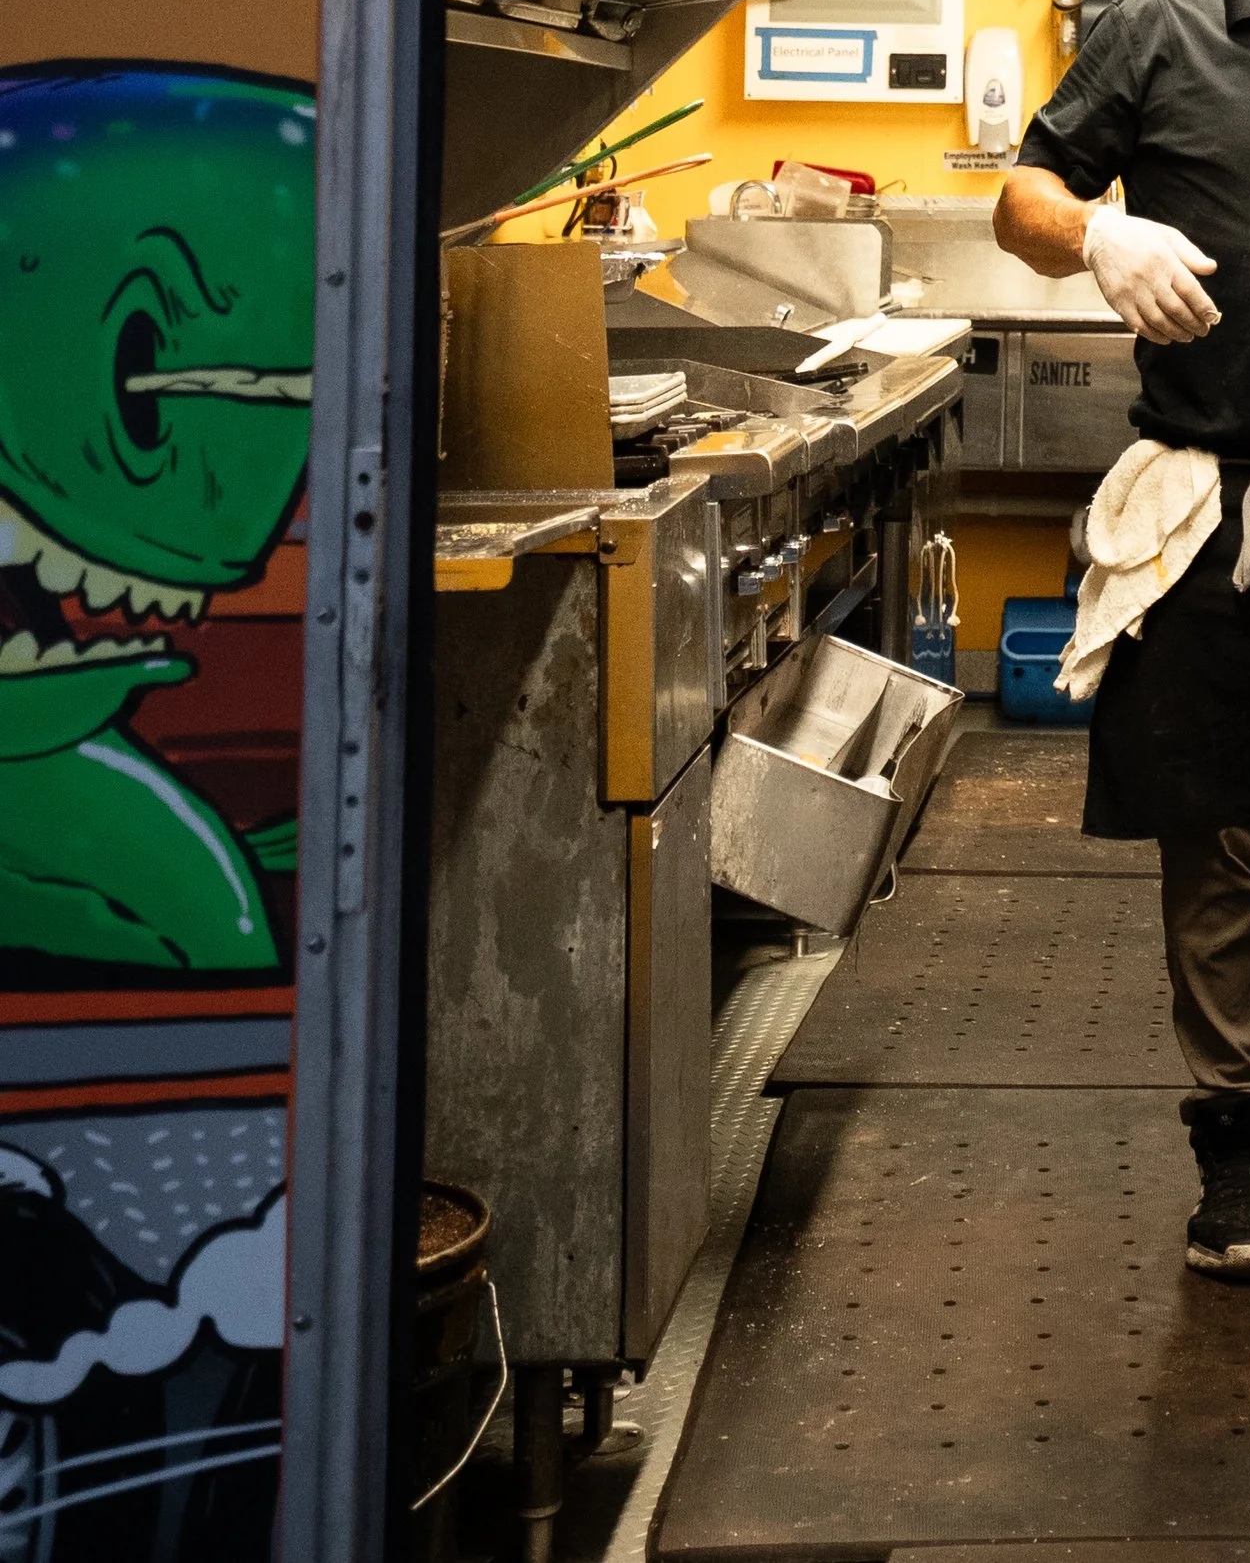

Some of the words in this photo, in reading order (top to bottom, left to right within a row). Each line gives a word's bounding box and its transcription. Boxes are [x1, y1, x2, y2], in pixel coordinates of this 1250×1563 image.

[772, 45, 824, 57] Electrical
[828, 46, 860, 57] Panel
[944, 151, 986, 161] Employees
[952, 162, 973, 170] Wash
[974, 162, 999, 170] Hands
[1030, 361, 1092, 387] SANITZE
